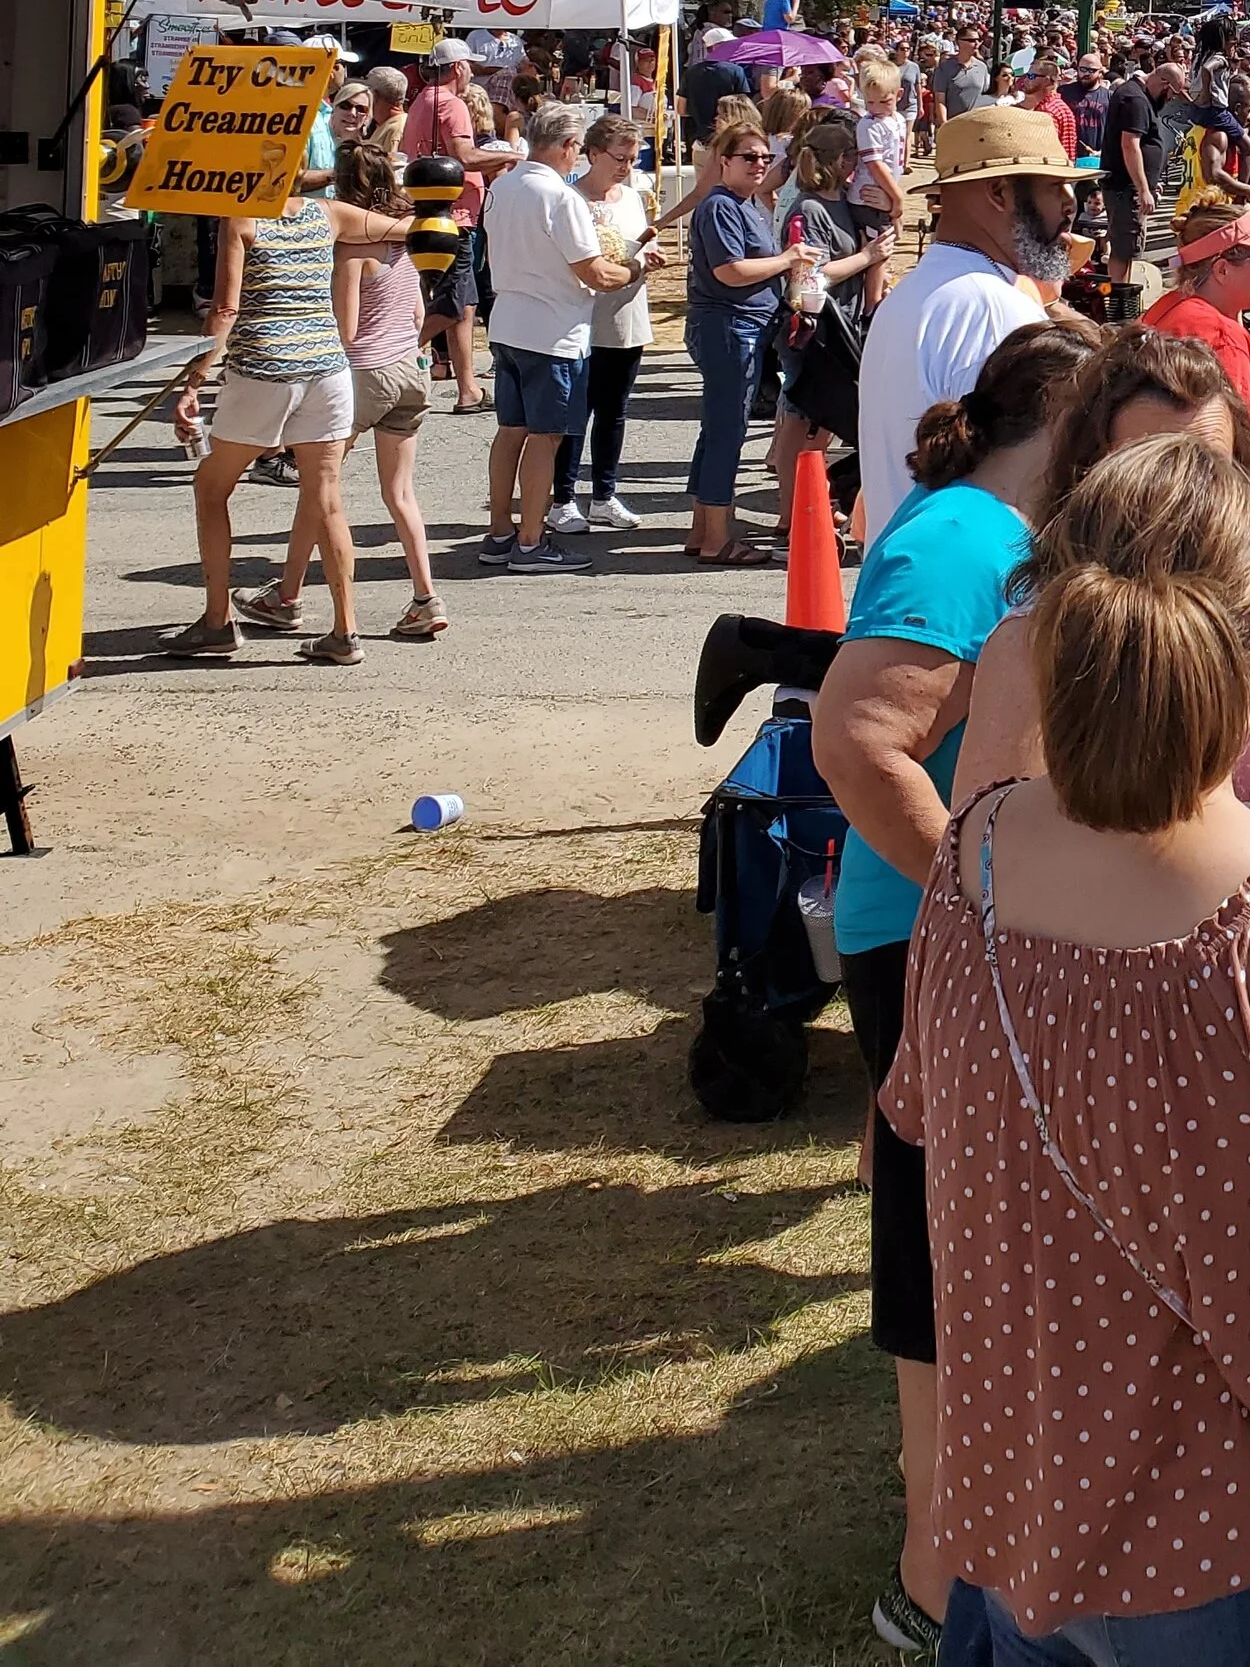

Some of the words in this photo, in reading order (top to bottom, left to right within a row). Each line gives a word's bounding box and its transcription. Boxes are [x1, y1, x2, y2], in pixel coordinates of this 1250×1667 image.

[188, 56, 244, 95] Try
[250, 58, 316, 89] Our
[163, 101, 308, 136] Creamed
[160, 160, 265, 201] Honey
